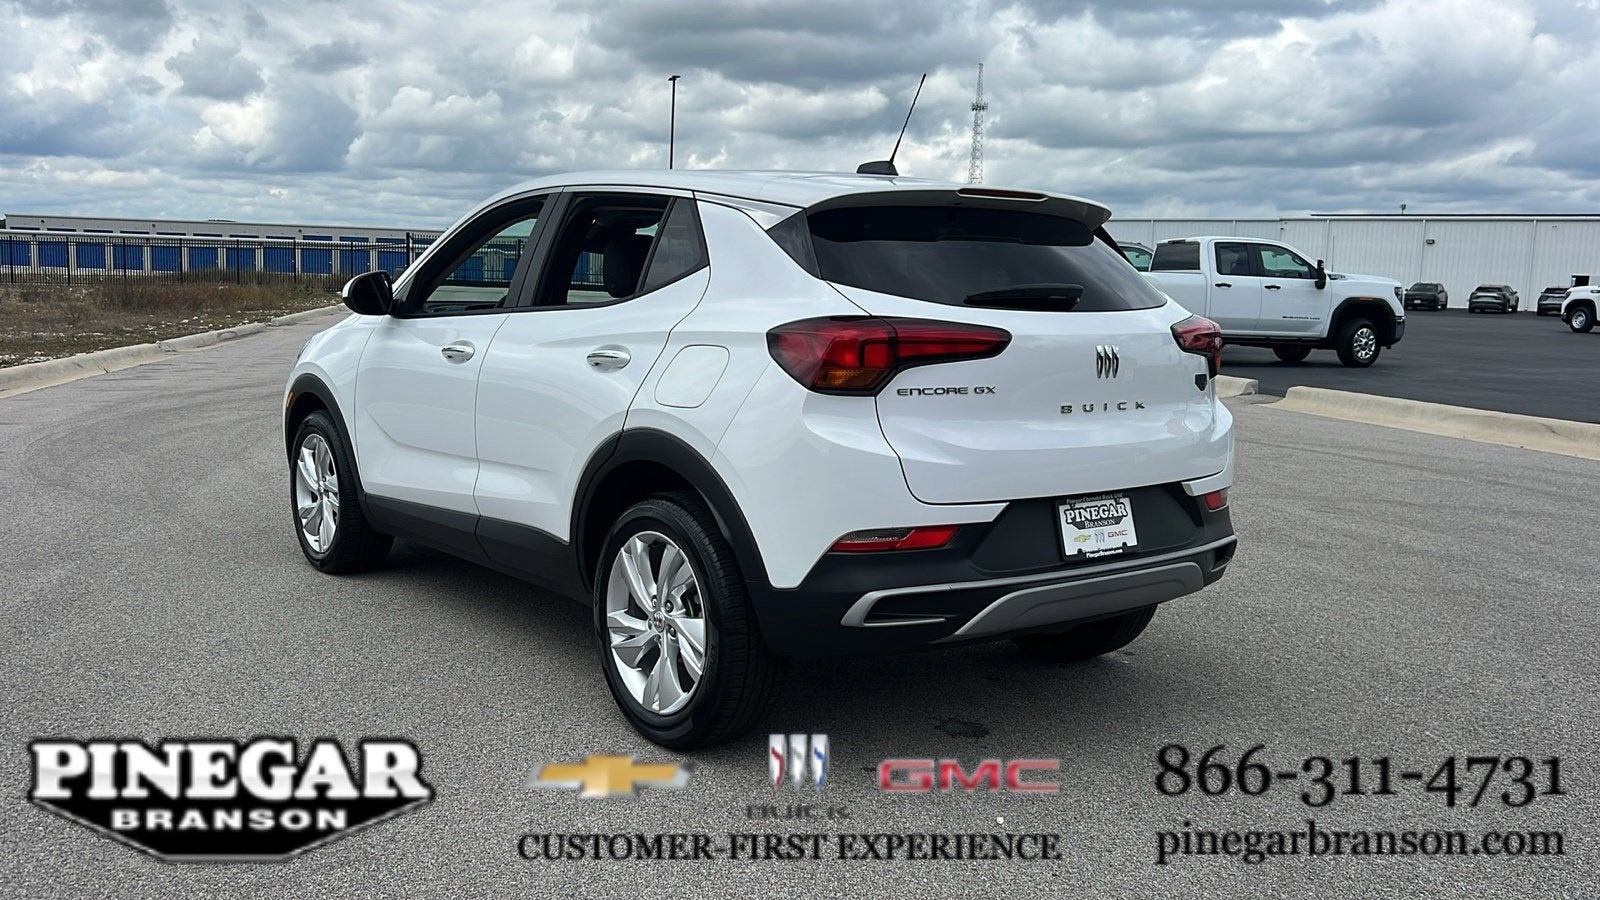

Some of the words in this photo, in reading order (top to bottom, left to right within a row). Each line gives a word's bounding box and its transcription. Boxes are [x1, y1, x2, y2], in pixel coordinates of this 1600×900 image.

[897, 387, 969, 396] ENCORE
[974, 386, 996, 395] GX
[1060, 401, 1146, 414] BUICK
[1065, 503, 1128, 523] PINEGAR
[1085, 519, 1115, 528] BRANSON
[1107, 530, 1128, 538] GMC
